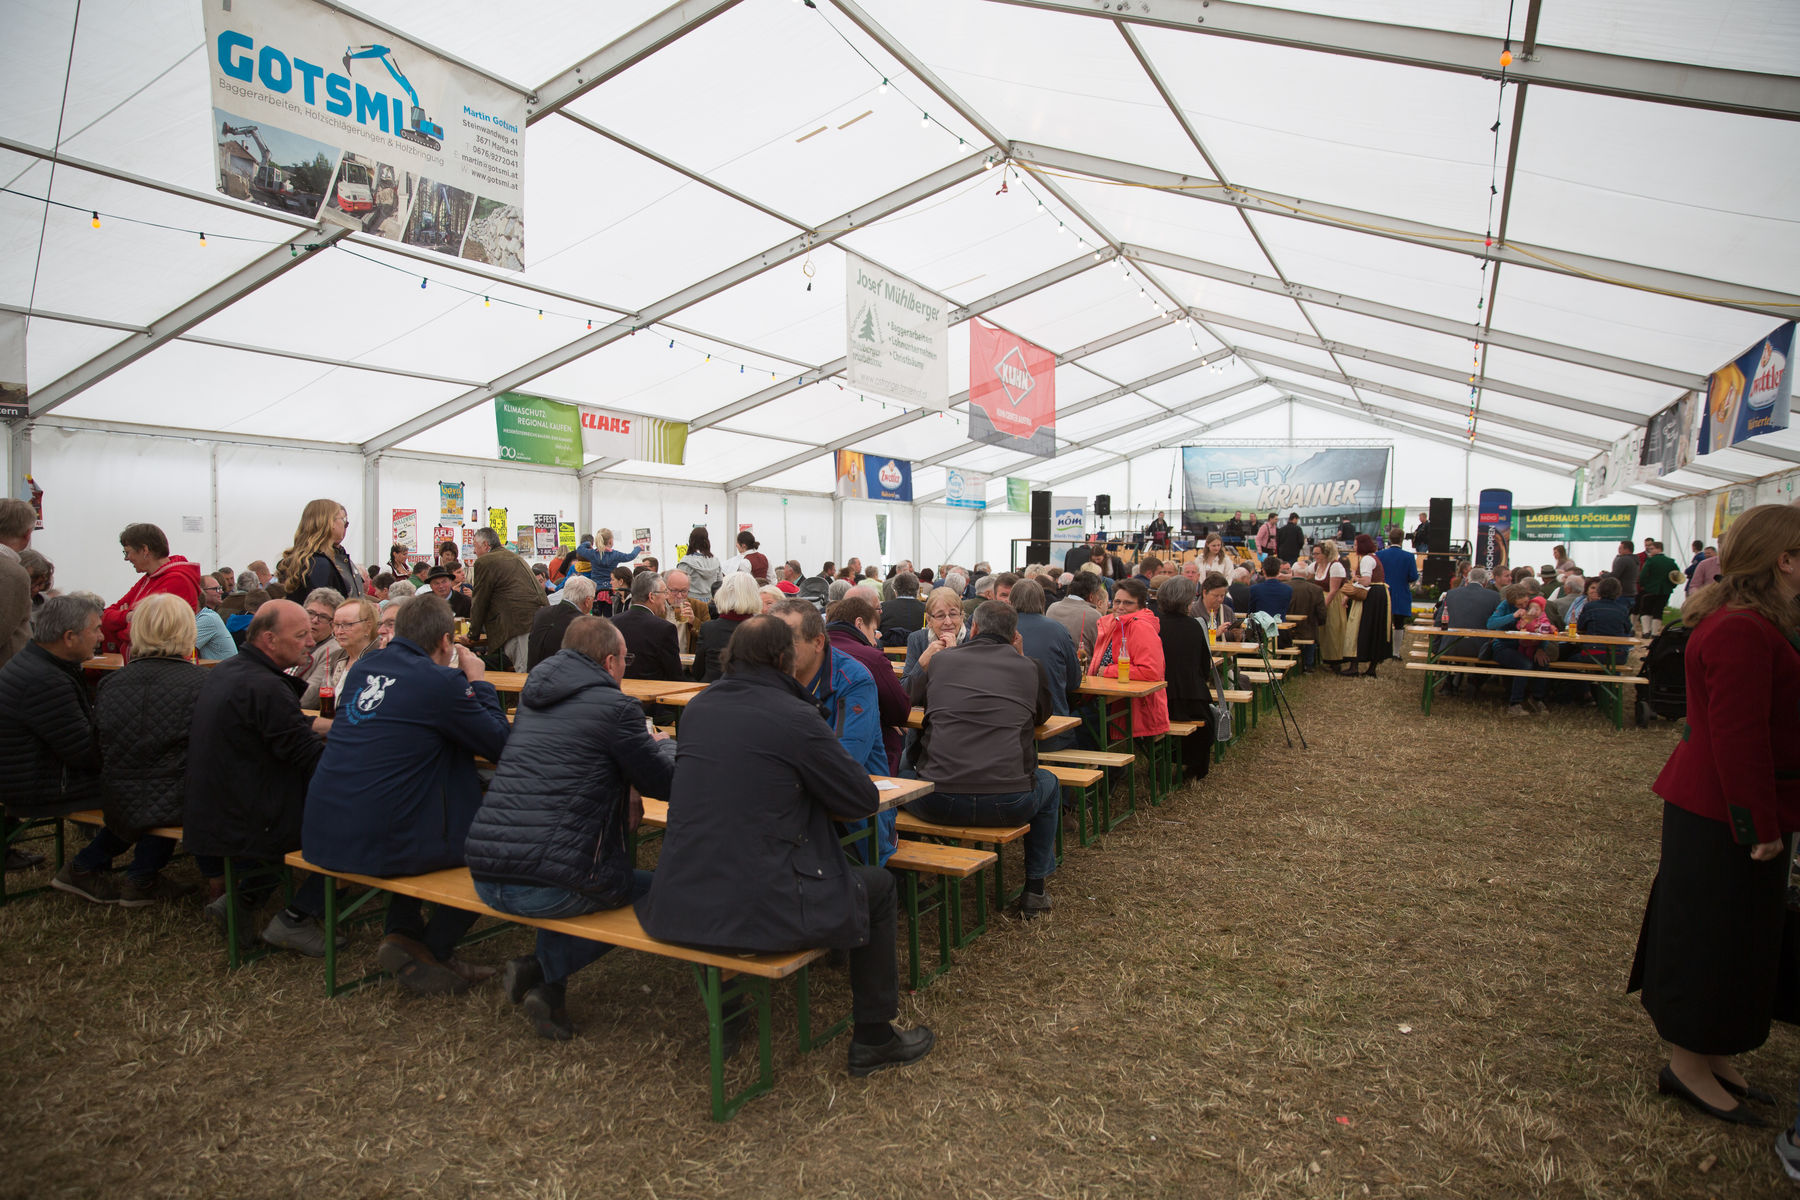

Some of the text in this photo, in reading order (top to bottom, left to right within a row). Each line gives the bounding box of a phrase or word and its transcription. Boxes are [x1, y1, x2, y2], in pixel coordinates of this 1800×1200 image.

[217, 30, 404, 138] GOTSMI
[219, 78, 445, 167] Baggerarbeiten, Holzschlägerungen & Holzbringung
[463, 105, 518, 134] Martin Gotsmi
[462, 119, 518, 146] Steinwandweg 41
[472, 145, 518, 168] 0676/9272041
[475, 134, 518, 157] 3671 Marbach
[461, 155, 518, 179] martin@gotsmi.at
[471, 169, 518, 190] www.gotsmi.at
[857, 268, 884, 296] Josef
[884, 282, 940, 321] Mühlberger
[890, 321, 933, 344] Baggerarbeiten
[517, 416, 574, 433] REGIONAL KAUFEN.
[581, 412, 631, 434] CLAAS
[1207, 464, 1294, 488] PARTY
[1257, 479, 1361, 512] KRAINER
[1526, 512, 1631, 522] LAGERHAUS PÖCHLARN
